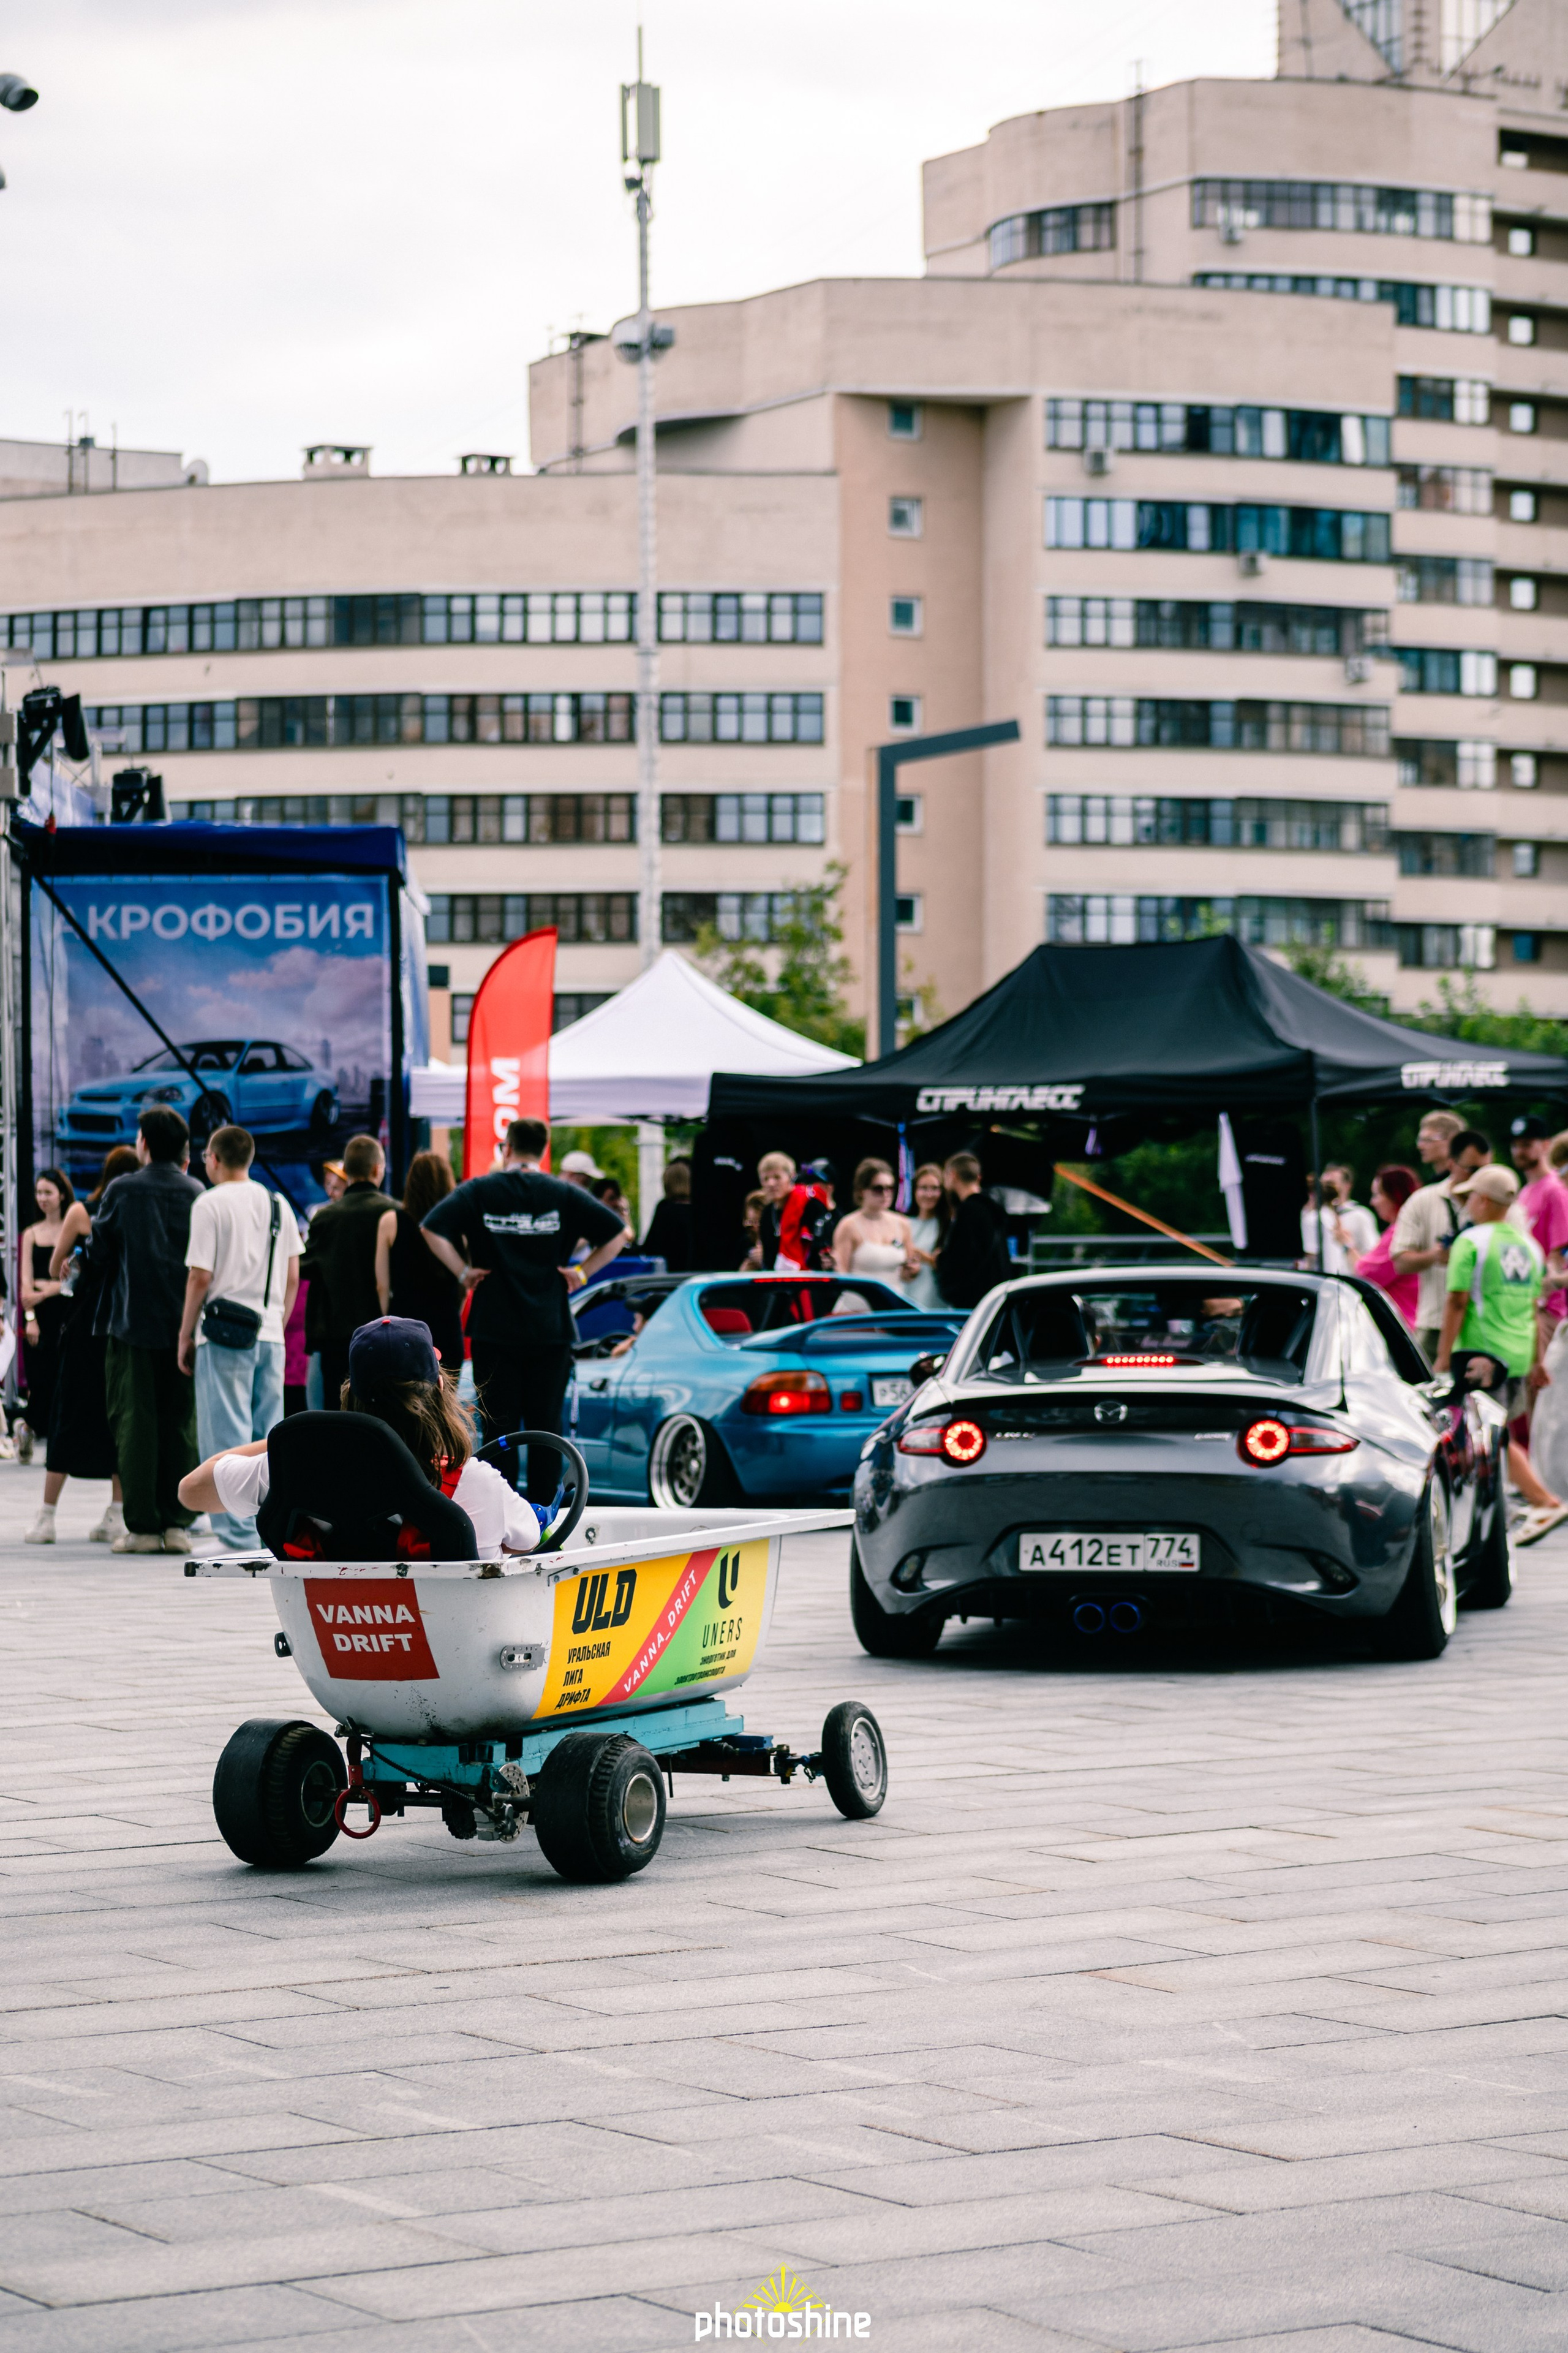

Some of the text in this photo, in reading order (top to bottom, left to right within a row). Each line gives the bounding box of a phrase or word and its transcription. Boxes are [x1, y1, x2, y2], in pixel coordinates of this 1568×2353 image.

[1030, 1537, 1191, 1566] А412ЕТ 774
[571, 1568, 637, 1634] ULD
[316, 1604, 416, 1624] VANNA
[333, 1633, 413, 1652] DRIFT
[702, 1617, 742, 1649] UNERS
[567, 1641, 611, 1664] УРАЛЬСКАЯ
[562, 1668, 583, 1687] ЛИГА
[554, 1688, 591, 1710] ДРИФТА
